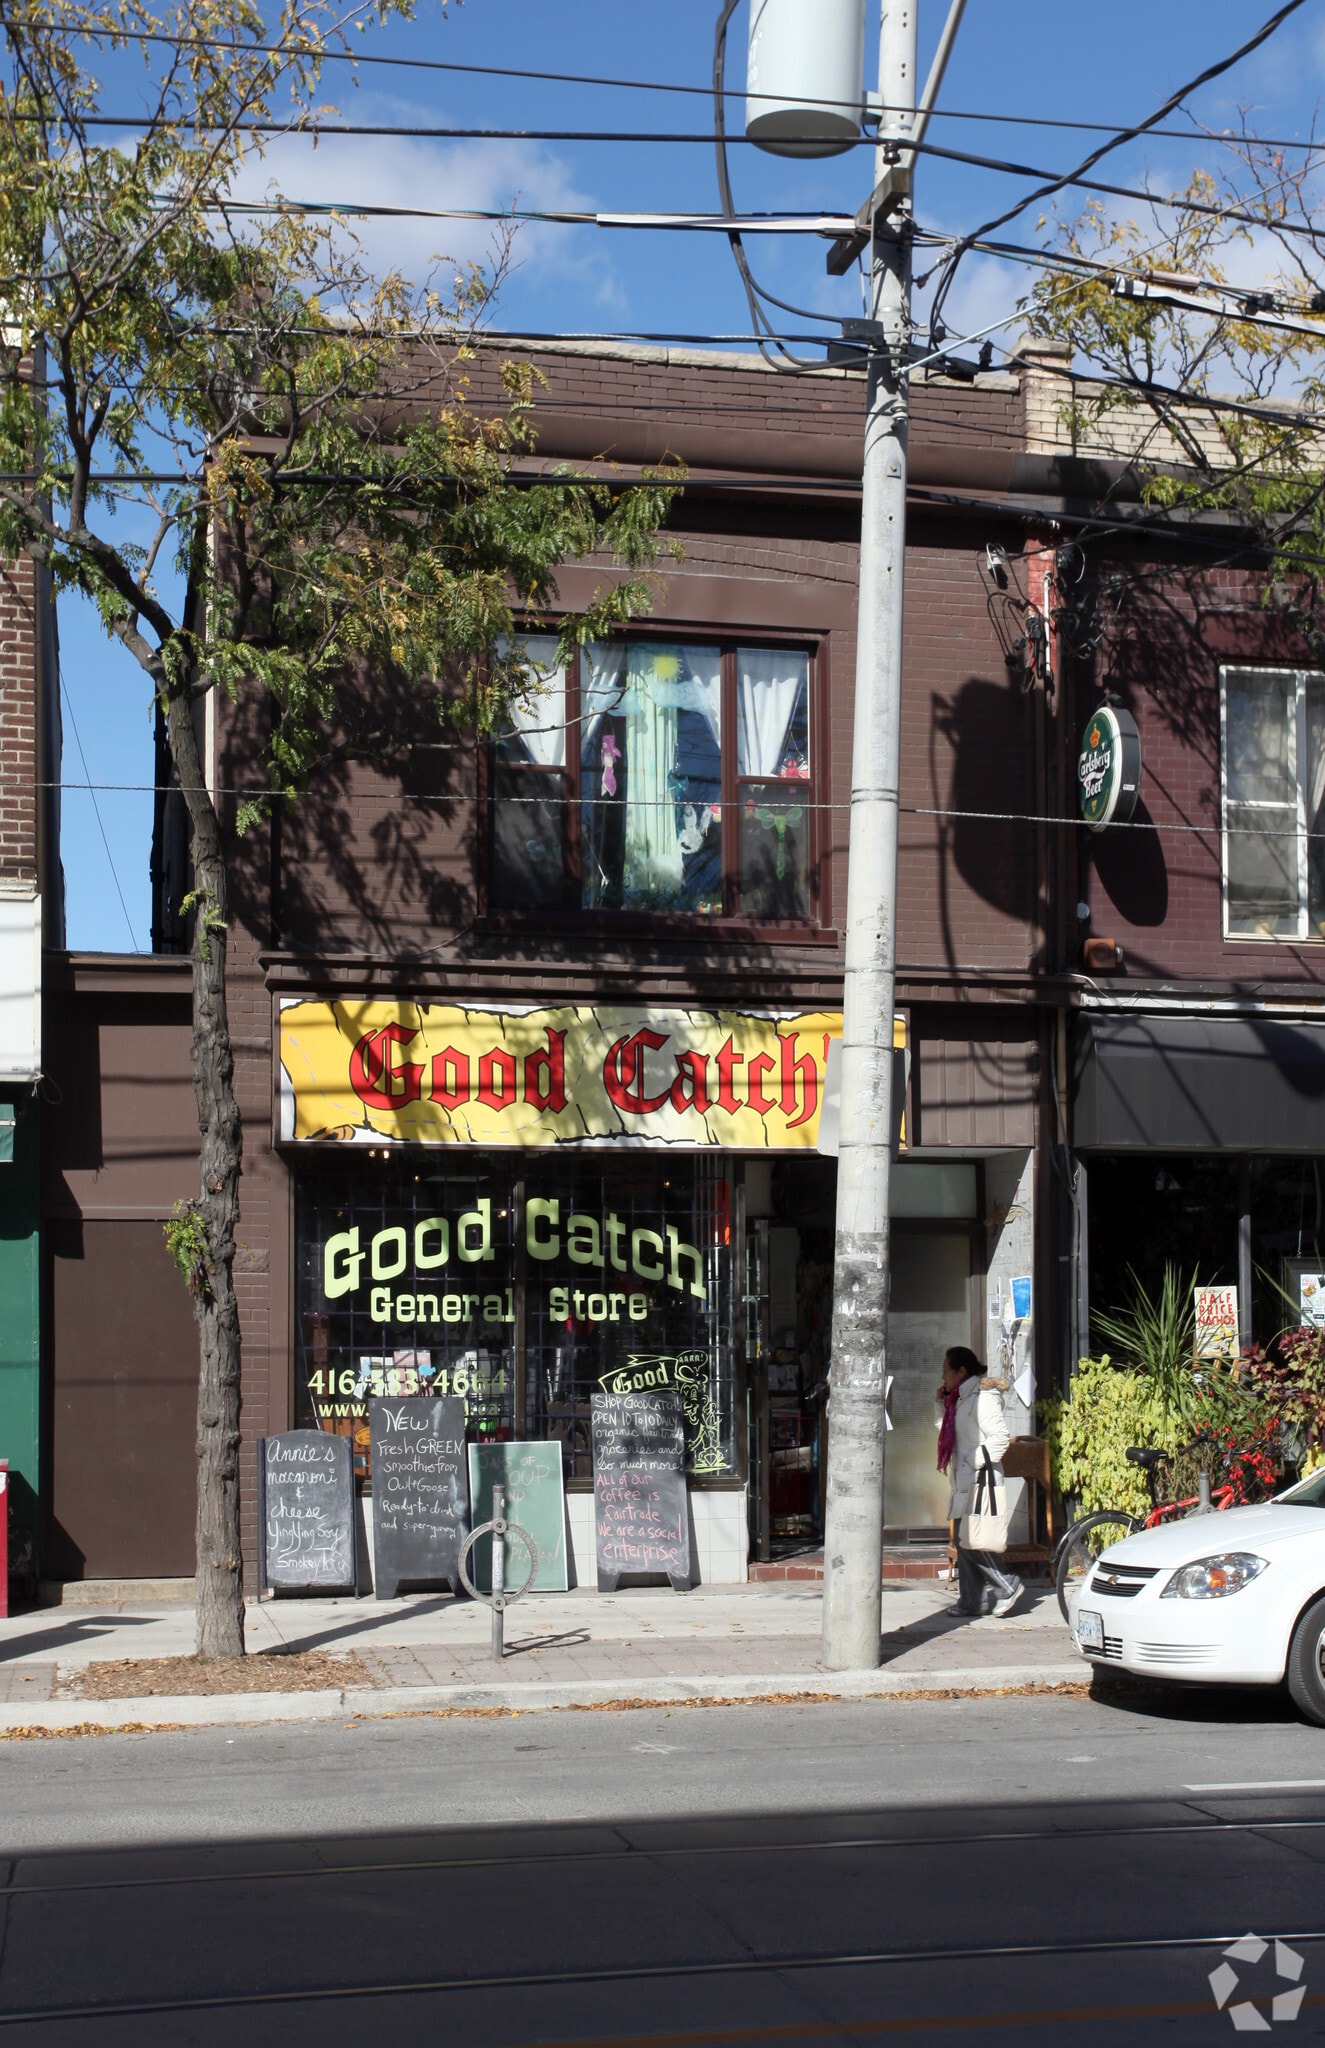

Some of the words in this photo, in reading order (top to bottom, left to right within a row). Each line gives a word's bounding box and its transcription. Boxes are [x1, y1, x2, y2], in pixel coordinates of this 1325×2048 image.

[1078, 743, 1110, 781] Carlsberg
[1083, 777, 1102, 799] Beer
[349, 1021, 570, 1114] Good
[324, 1198, 495, 1299] Good
[526, 1197, 707, 1299] Catch
[371, 1287, 515, 1323] General
[549, 1287, 648, 1321] Store
[1200, 1293, 1231, 1304] HALF
[1199, 1304, 1233, 1315] PRICE
[1198, 1315, 1235, 1326] NACHOS
[612, 1362, 669, 1394] Good
[594, 1396, 622, 1410] SHOP
[592, 1410, 617, 1426] OPEN
[596, 1427, 640, 1445] organic
[267, 1439, 336, 1463] Annie's
[377, 1437, 414, 1457] Fresh
[416, 1437, 465, 1456] GREEN
[597, 1445, 656, 1465] groceries
[658, 1442, 684, 1455] and
[520, 1455, 536, 1466] OF
[620, 1457, 648, 1471] much
[267, 1468, 338, 1485] macaroni
[619, 1471, 630, 1487] of
[631, 1474, 653, 1485] our
[649, 1491, 660, 1502] is
[270, 1497, 328, 1519] cheese
[605, 1502, 661, 1522] fairtrade
[381, 1516, 397, 1529] and
[598, 1521, 614, 1537] We
[616, 1525, 635, 1537] are
[638, 1526, 645, 1538] a
[647, 1513, 682, 1544] social
[603, 1537, 680, 1568] enterprise
